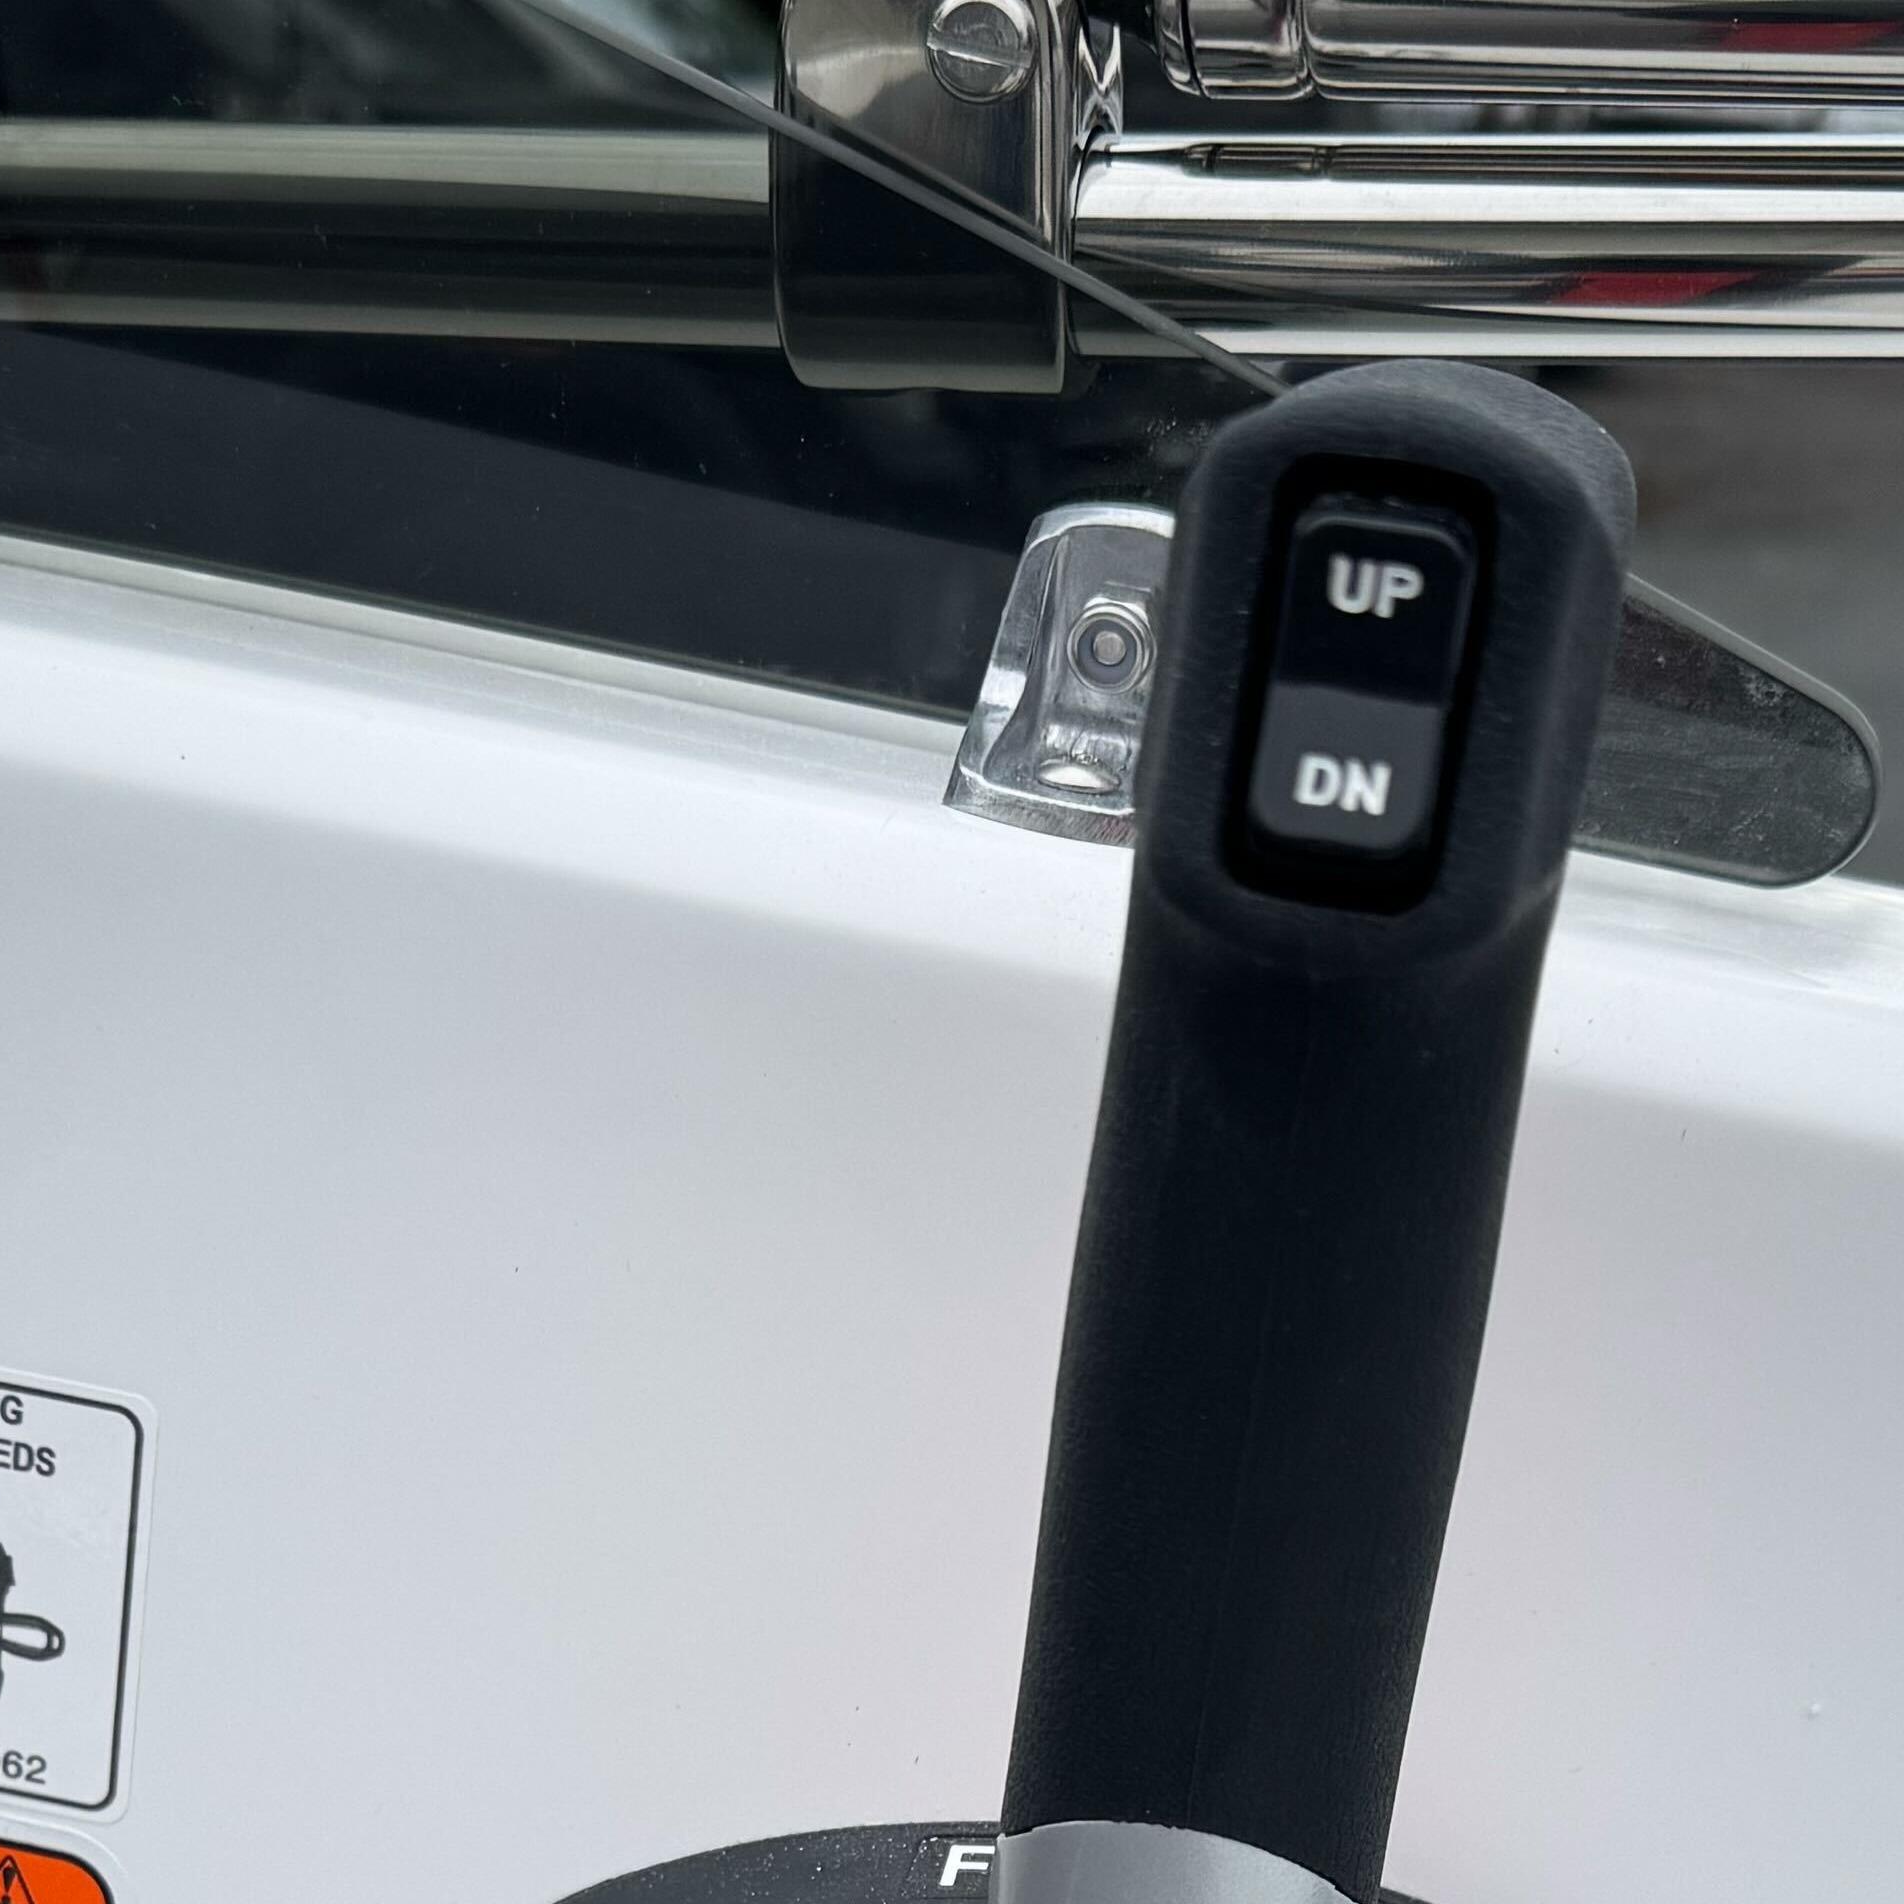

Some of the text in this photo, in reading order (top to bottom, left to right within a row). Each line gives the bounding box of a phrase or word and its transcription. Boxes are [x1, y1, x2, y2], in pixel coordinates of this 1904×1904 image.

[1327, 556, 1424, 619] UP
[1294, 753, 1391, 816] DN
[939, 1844, 995, 1887] F
